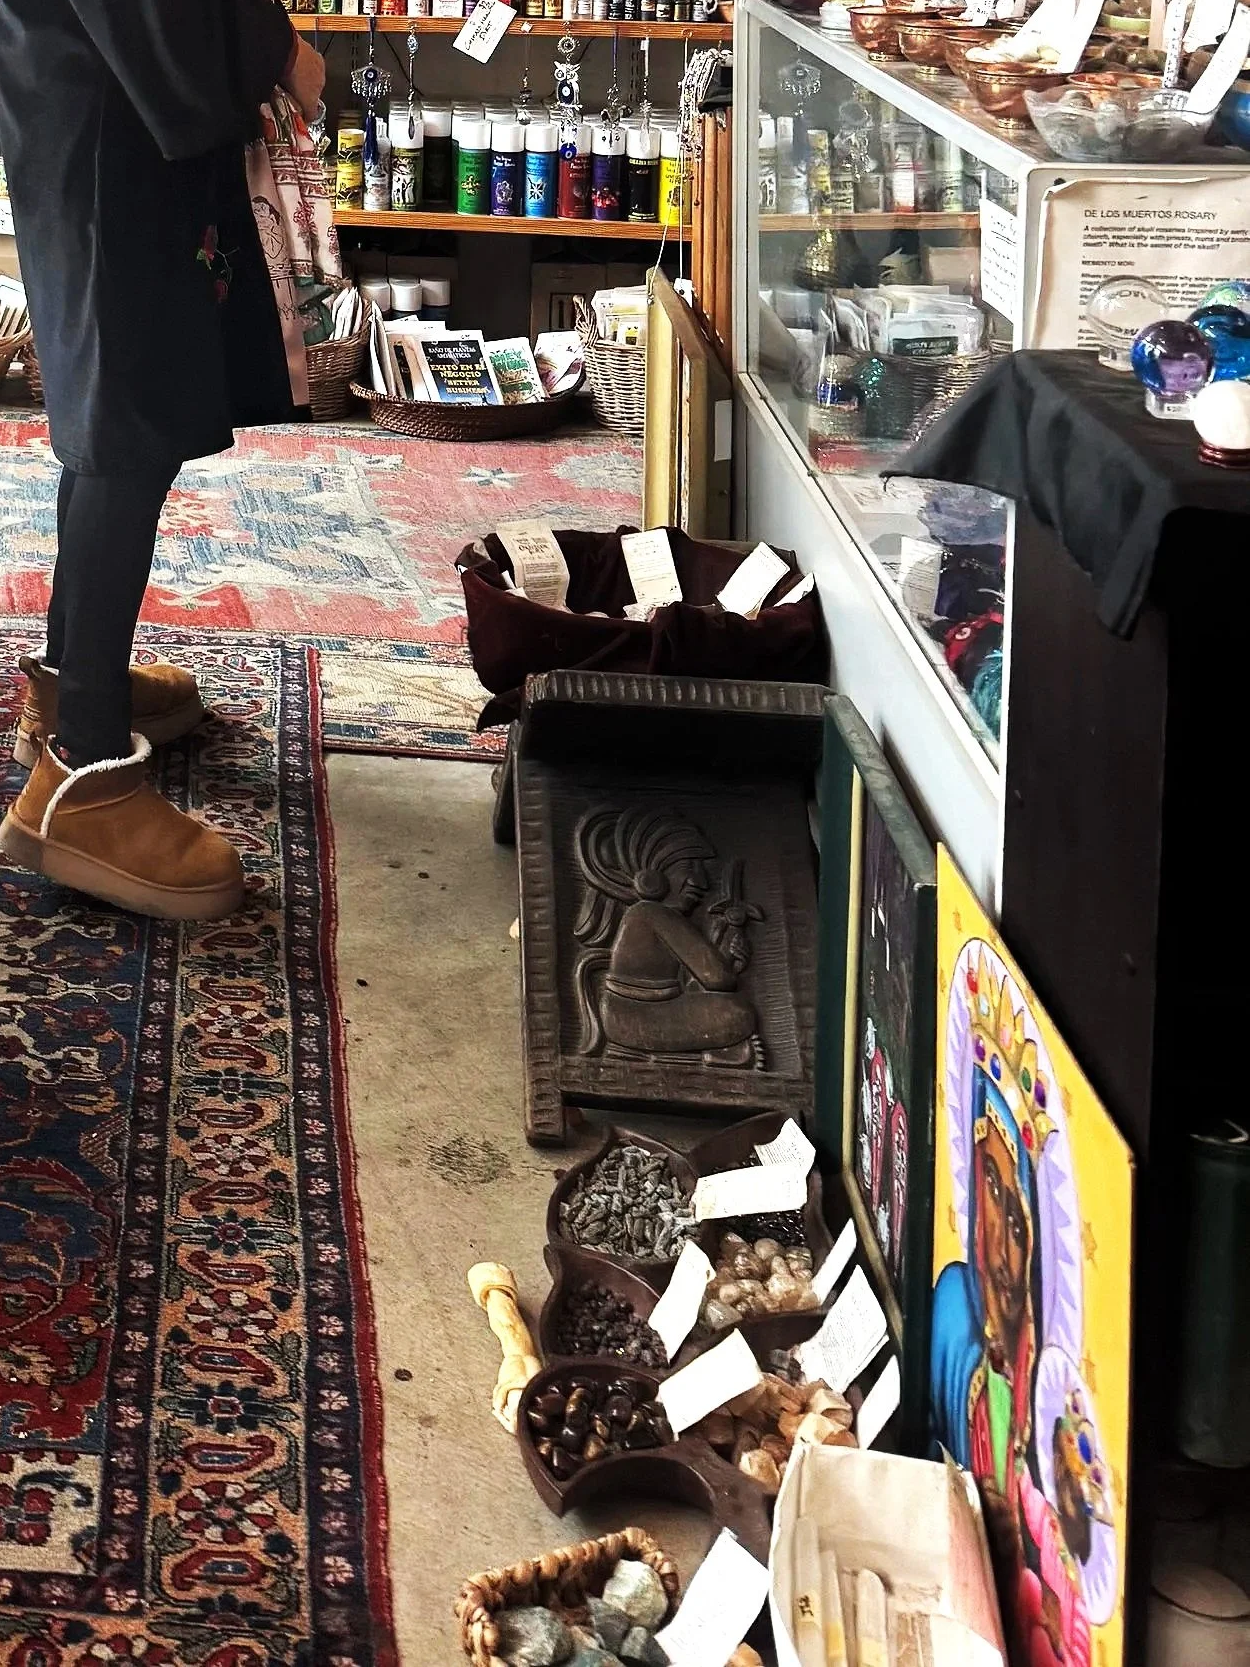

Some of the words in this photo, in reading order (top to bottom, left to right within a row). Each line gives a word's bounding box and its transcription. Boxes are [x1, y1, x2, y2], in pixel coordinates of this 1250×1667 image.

[1084, 210, 1097, 218] DE
[1101, 210, 1120, 218] LOS
[1123, 210, 1172, 219] MUERTOS
[1175, 212, 1217, 220] ROSARY
